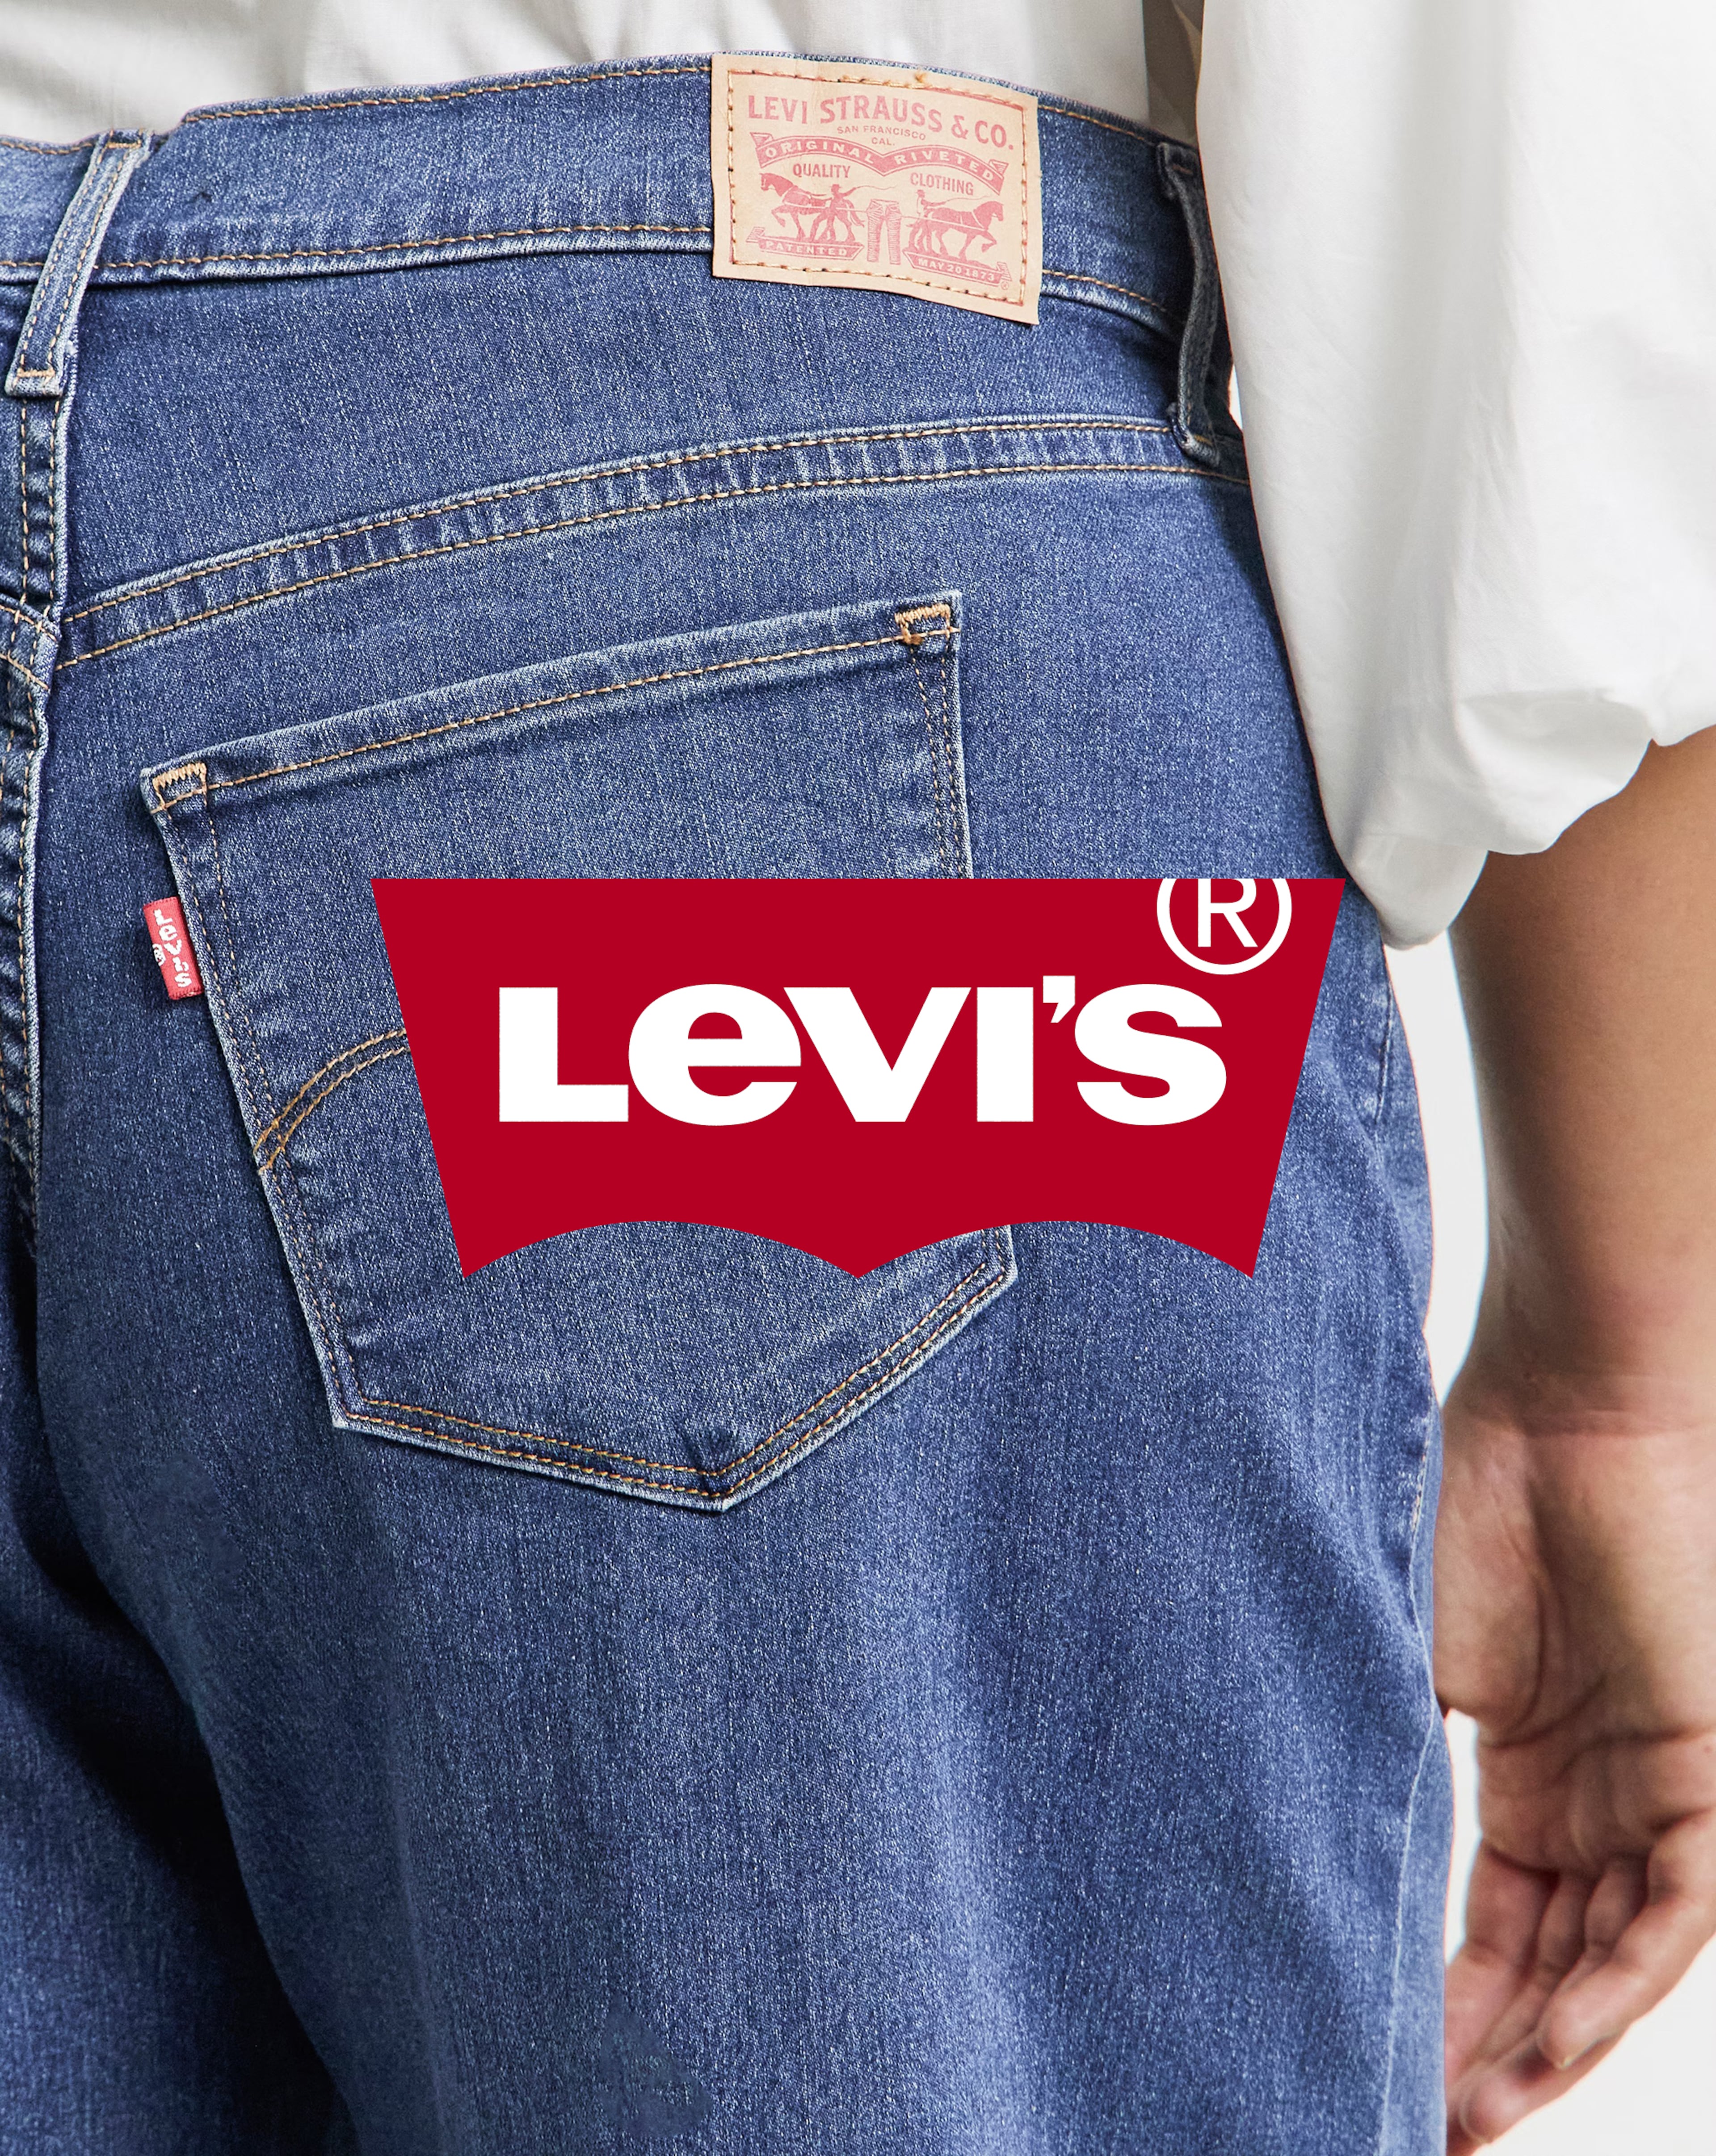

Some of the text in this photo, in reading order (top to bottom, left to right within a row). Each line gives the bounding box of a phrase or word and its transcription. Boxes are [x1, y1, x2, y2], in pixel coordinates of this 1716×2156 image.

[748, 95, 1014, 150] LEVI STRAUSS & CO.
[837, 125, 926, 141] SAN FRANCISCO
[871, 137, 896, 146] CAL.
[765, 140, 994, 181] ORIGINAL RIVETED
[792, 163, 851, 178] QUALITY
[910, 172, 974, 196] CLOTHING
[765, 240, 848, 256] PATENTED
[917, 257, 996, 282] MAY 20 1873
